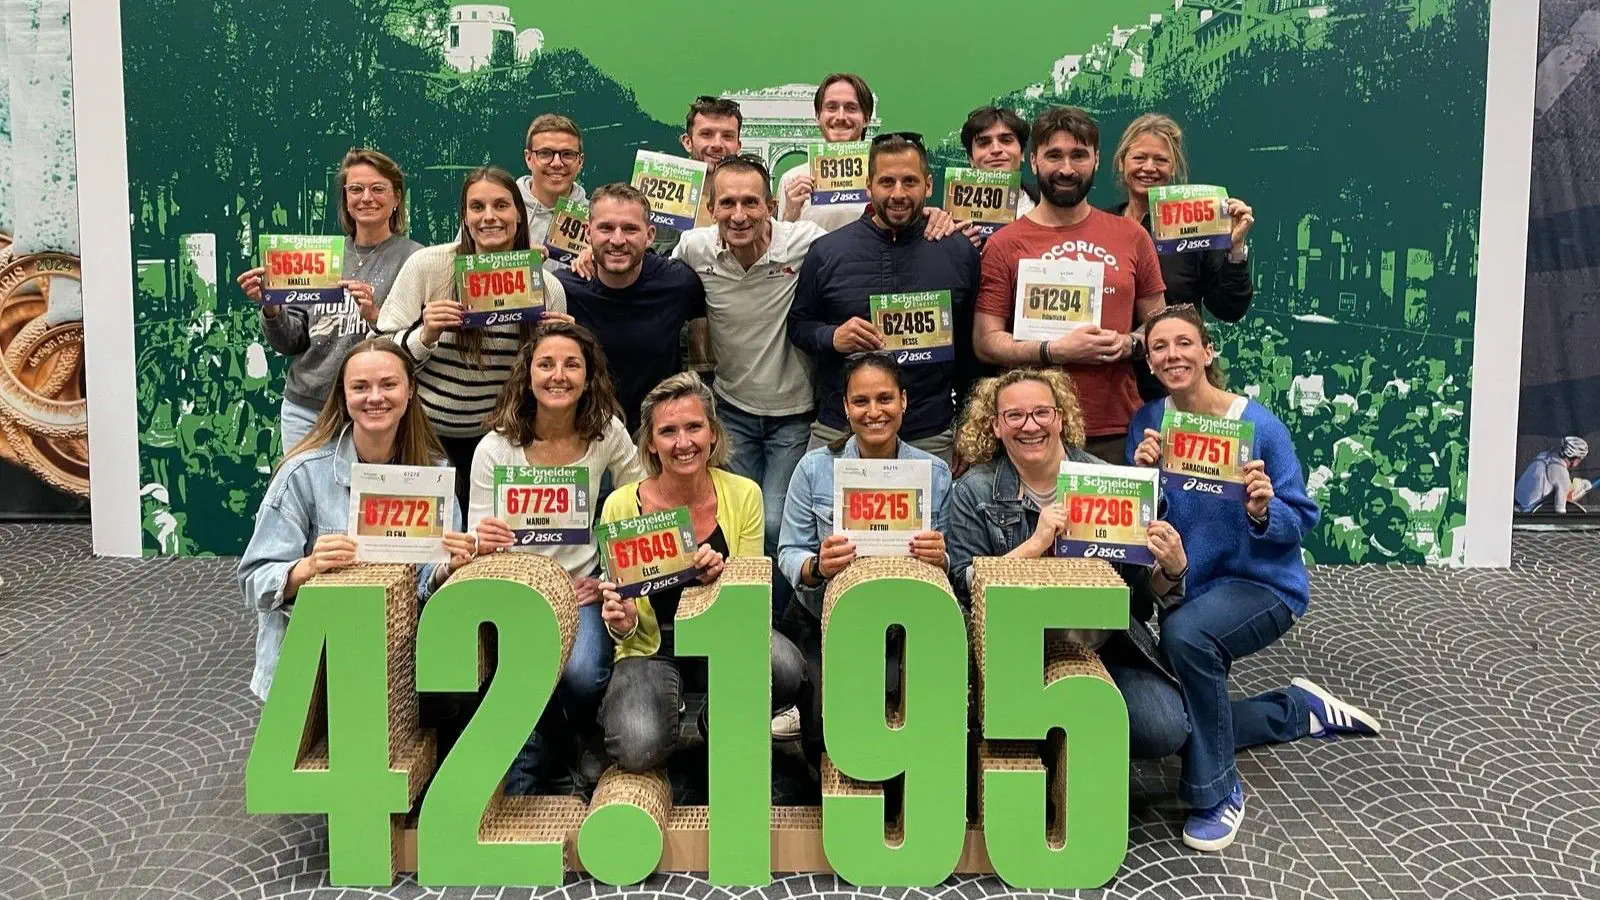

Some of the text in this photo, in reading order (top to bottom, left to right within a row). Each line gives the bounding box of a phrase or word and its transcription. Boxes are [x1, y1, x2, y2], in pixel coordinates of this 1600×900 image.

[653, 161, 696, 177] Schneider
[820, 158, 863, 179] 63193
[966, 168, 1011, 180] Schneider
[640, 177, 685, 203] 62524
[954, 185, 1003, 210] 62430
[654, 202, 664, 210] FLO
[1162, 200, 1215, 225] 67665
[560, 217, 589, 242] 491
[271, 252, 326, 275] 56345
[478, 252, 531, 264] Schneider
[1041, 240, 1120, 271] OCORICO.
[0, 258, 73, 298] ARIS 2024
[469, 270, 526, 297] 67064
[891, 292, 941, 304] Schneider
[1029, 286, 1082, 313] 61294
[338, 316, 367, 337] LIGH
[882, 311, 935, 336] 62485
[1187, 413, 1242, 431] Schneider
[1209, 427, 1241, 437] Electric
[1173, 432, 1231, 465] 67751
[520, 467, 578, 477] Schneider
[1182, 462, 1220, 476] SARACHACHA
[1083, 475, 1142, 490] Schneider
[1108, 487, 1141, 496] Electric
[507, 487, 569, 515] 67729
[848, 491, 909, 521] 65215
[364, 497, 430, 527] 67272
[526, 517, 550, 526] MARION
[620, 511, 677, 530] Schneider
[1070, 496, 1133, 527] 67296
[646, 520, 679, 531] Electric
[1095, 528, 1107, 539] LÉO
[535, 532, 563, 542] asics
[614, 532, 678, 569] 67649
[1097, 547, 1126, 559] asics
[642, 565, 660, 577] ÉLISE
[652, 575, 679, 590] asics
[246, 578, 1130, 889] 42.195
